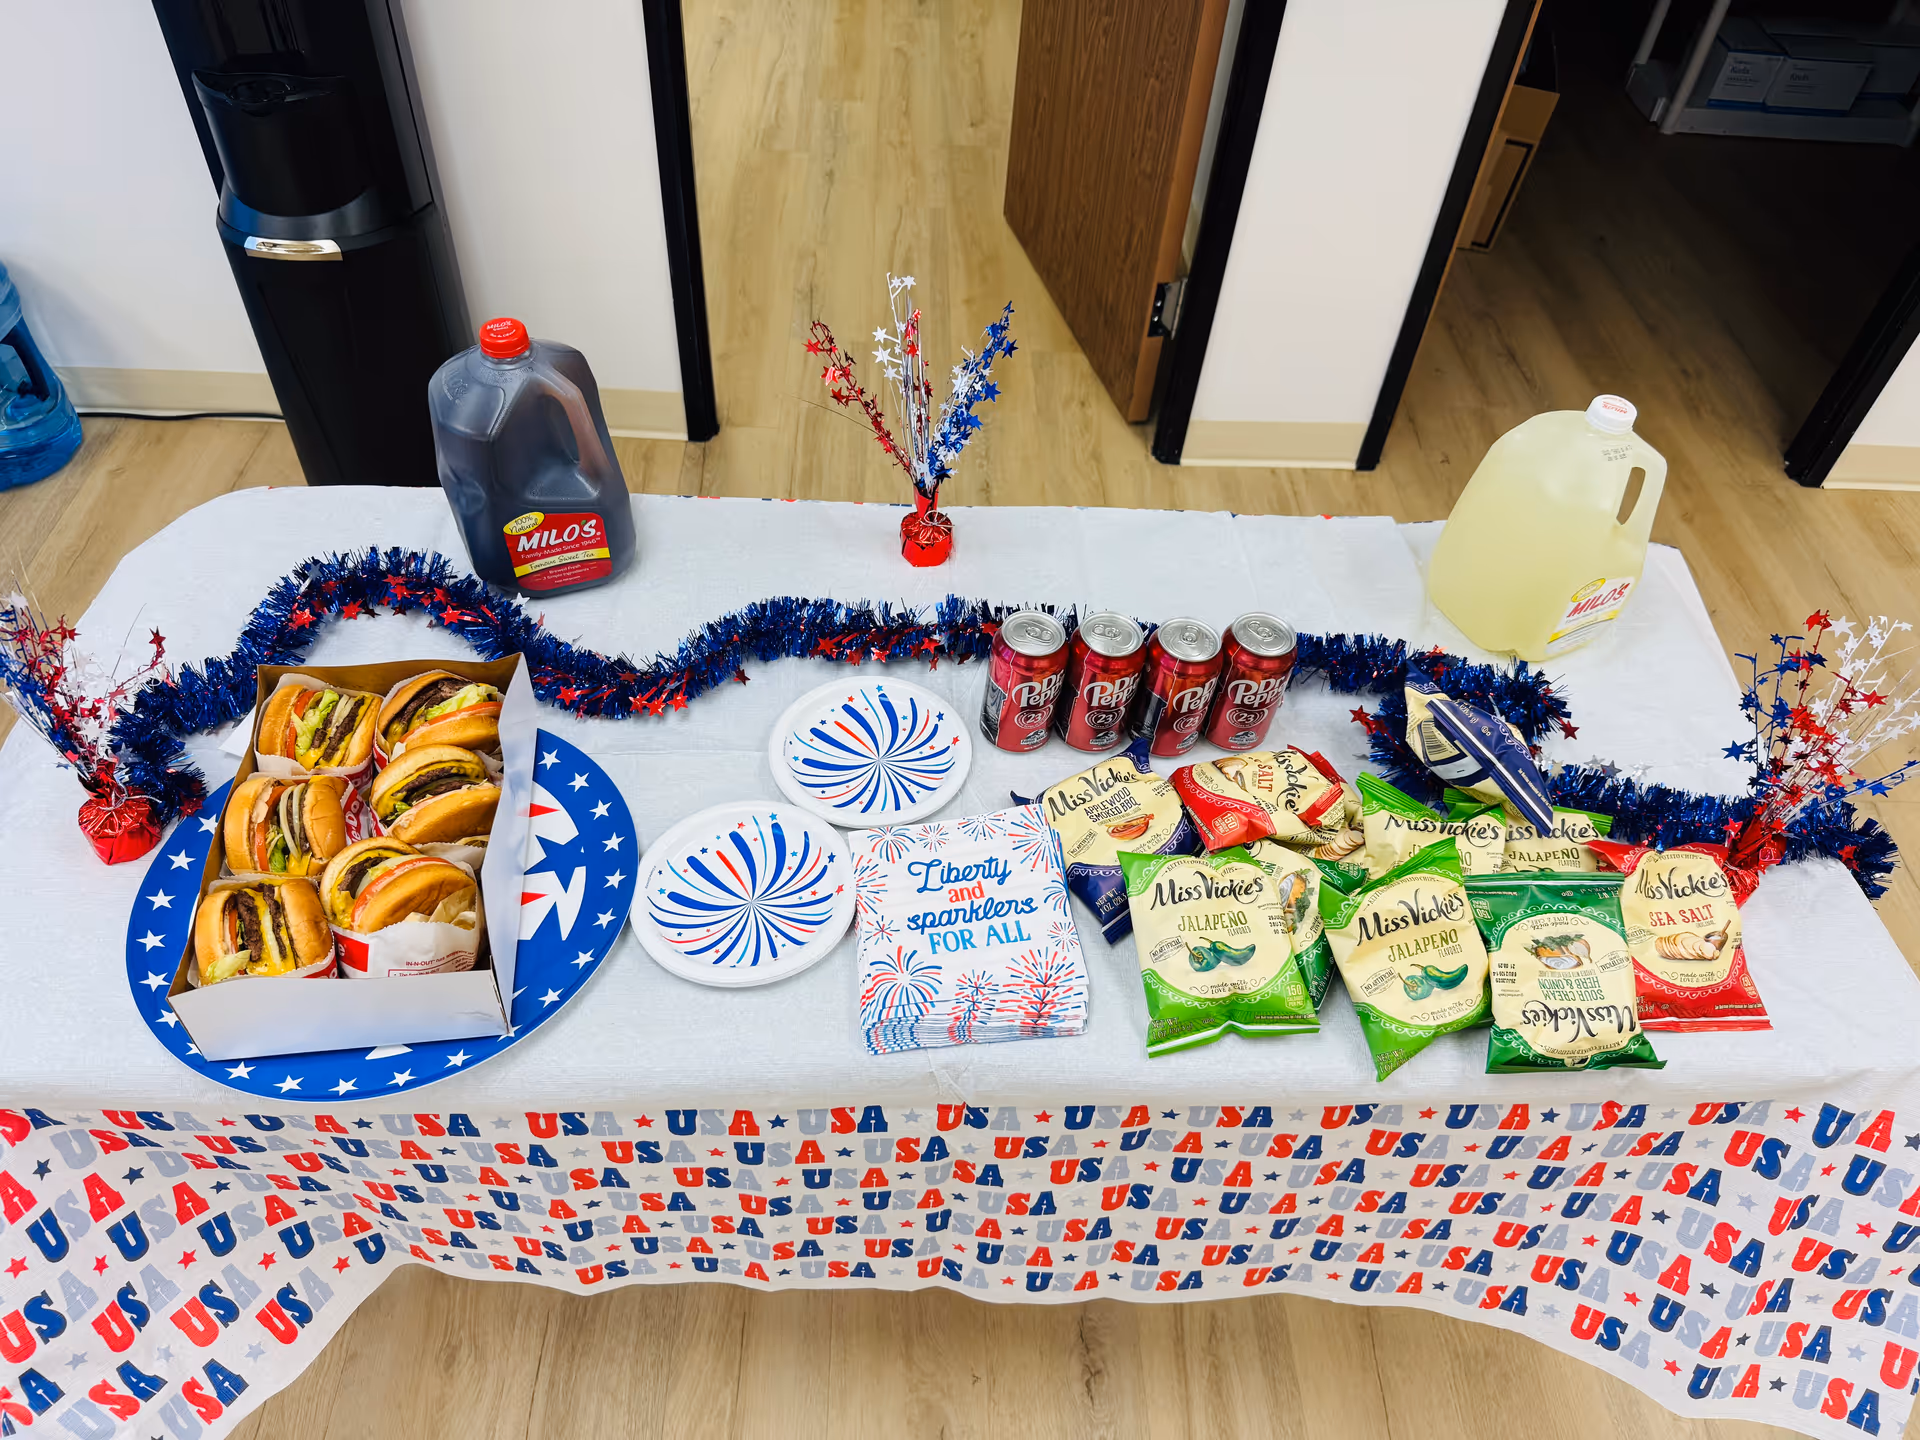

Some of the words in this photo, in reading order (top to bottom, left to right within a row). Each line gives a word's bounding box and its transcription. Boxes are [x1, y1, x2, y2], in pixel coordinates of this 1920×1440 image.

[509, 518, 540, 534] Natural
[514, 514, 534, 526] 100%
[517, 519, 597, 552] MILO'S
[1566, 583, 1630, 618] MILO'S
[1114, 673, 1139, 691] Dr
[1259, 676, 1286, 694] Dr
[1026, 713, 1042, 723] 23
[1097, 714, 1112, 723] 23
[1186, 716, 1199, 727] 23
[1238, 712, 1254, 722] 23
[1258, 764, 1274, 792] SALT
[1048, 789, 1094, 822] Miss
[1084, 786, 1131, 816] APPLEWOOD
[1088, 804, 1122, 823] SMOKED
[1122, 796, 1142, 813] BBQ
[1222, 814, 1237, 828] 150
[1506, 825, 1534, 841] iss
[1508, 848, 1580, 862] JALAPEÑO
[1558, 860, 1580, 868] FLAVORED
[908, 856, 1012, 893] Liberty
[1634, 868, 1663, 899] Miss
[1657, 866, 1728, 900] Vickie's
[948, 881, 985, 904] and
[1096, 895, 1108, 907] NET
[1150, 879, 1202, 910] Miss
[1193, 870, 1264, 904] Vickie's
[906, 897, 1038, 936] sparklers
[1178, 910, 1248, 932] JALAPEÑO
[1357, 912, 1409, 946] Miss
[1397, 888, 1465, 925] Vickie's
[1475, 909, 1490, 918] 150
[1649, 911, 1677, 927] SEA
[1678, 904, 1714, 923] SALT
[928, 928, 977, 955] FOR
[986, 920, 1032, 946] ALL
[1227, 926, 1251, 936] FLAVORED
[1160, 938, 1181, 952] ARTIFICIAL
[1388, 928, 1459, 962] JALAPEÑO
[1438, 944, 1462, 958] FLAVORED
[1287, 984, 1302, 996] 150
[1364, 984, 1373, 992] NO
[1372, 969, 1394, 986] ARTIFICIAL
[1538, 978, 1565, 990] ONION
[1564, 978, 1574, 989] &
[1575, 976, 1601, 989] HERB
[1448, 1001, 1464, 1010] with
[1542, 990, 1576, 1001] CREAM
[1577, 989, 1605, 1001] SOUR
[1152, 1019, 1165, 1028] NET
[1521, 1000, 1598, 1043] Vickie's
[99, 1109, 213, 1131] USA
[525, 1111, 623, 1139] USA
[665, 1109, 760, 1136] USA
[1320, 1103, 1403, 1129] USA
[1445, 1104, 1530, 1130] USA
[1688, 1100, 1775, 1126] USA
[863, 1135, 950, 1164] USA
[994, 1135, 1077, 1159] USA
[1120, 1128, 1203, 1154] USA
[1365, 1129, 1450, 1160] USA
[1485, 1135, 1572, 1161] USA
[146, 1151, 251, 1178] USA
[460, 1142, 559, 1168] USA
[233, 1172, 331, 1192] USA
[802, 1167, 889, 1189] USA
[1050, 1156, 1129, 1185] USA
[1287, 1158, 1365, 1188] USA
[1409, 1164, 1490, 1188] USA
[362, 1180, 455, 1204] USA
[488, 1189, 578, 1219] USA
[862, 1188, 945, 1210] USA
[976, 1190, 1057, 1215] USA
[1449, 1192, 1529, 1218] USA
[443, 1208, 531, 1234] USA
[680, 1215, 764, 1238] USA
[926, 1209, 1002, 1239] USA
[1036, 1216, 1112, 1242] USA
[1155, 1216, 1231, 1240] USA
[1768, 1195, 1845, 1237] USA
[864, 1236, 941, 1258] USA
[1493, 1221, 1569, 1250] USA
[1676, 1206, 1765, 1278] USA
[976, 1242, 1053, 1267] USA
[1310, 1239, 1384, 1264] USA
[1416, 1244, 1493, 1276] USA
[1606, 1230, 1691, 1296] USA
[800, 1261, 876, 1279] USA
[917, 1256, 989, 1289] USA
[1130, 1270, 1203, 1291] USA
[1350, 1268, 1423, 1294] USA
[91, 1263, 182, 1352] USA
[1725, 1278, 1794, 1320] USA
[0, 1269, 98, 1363] USA
[1570, 1303, 1651, 1370] USA
[157, 1358, 249, 1440] USA
[1792, 1369, 1881, 1437] USA
